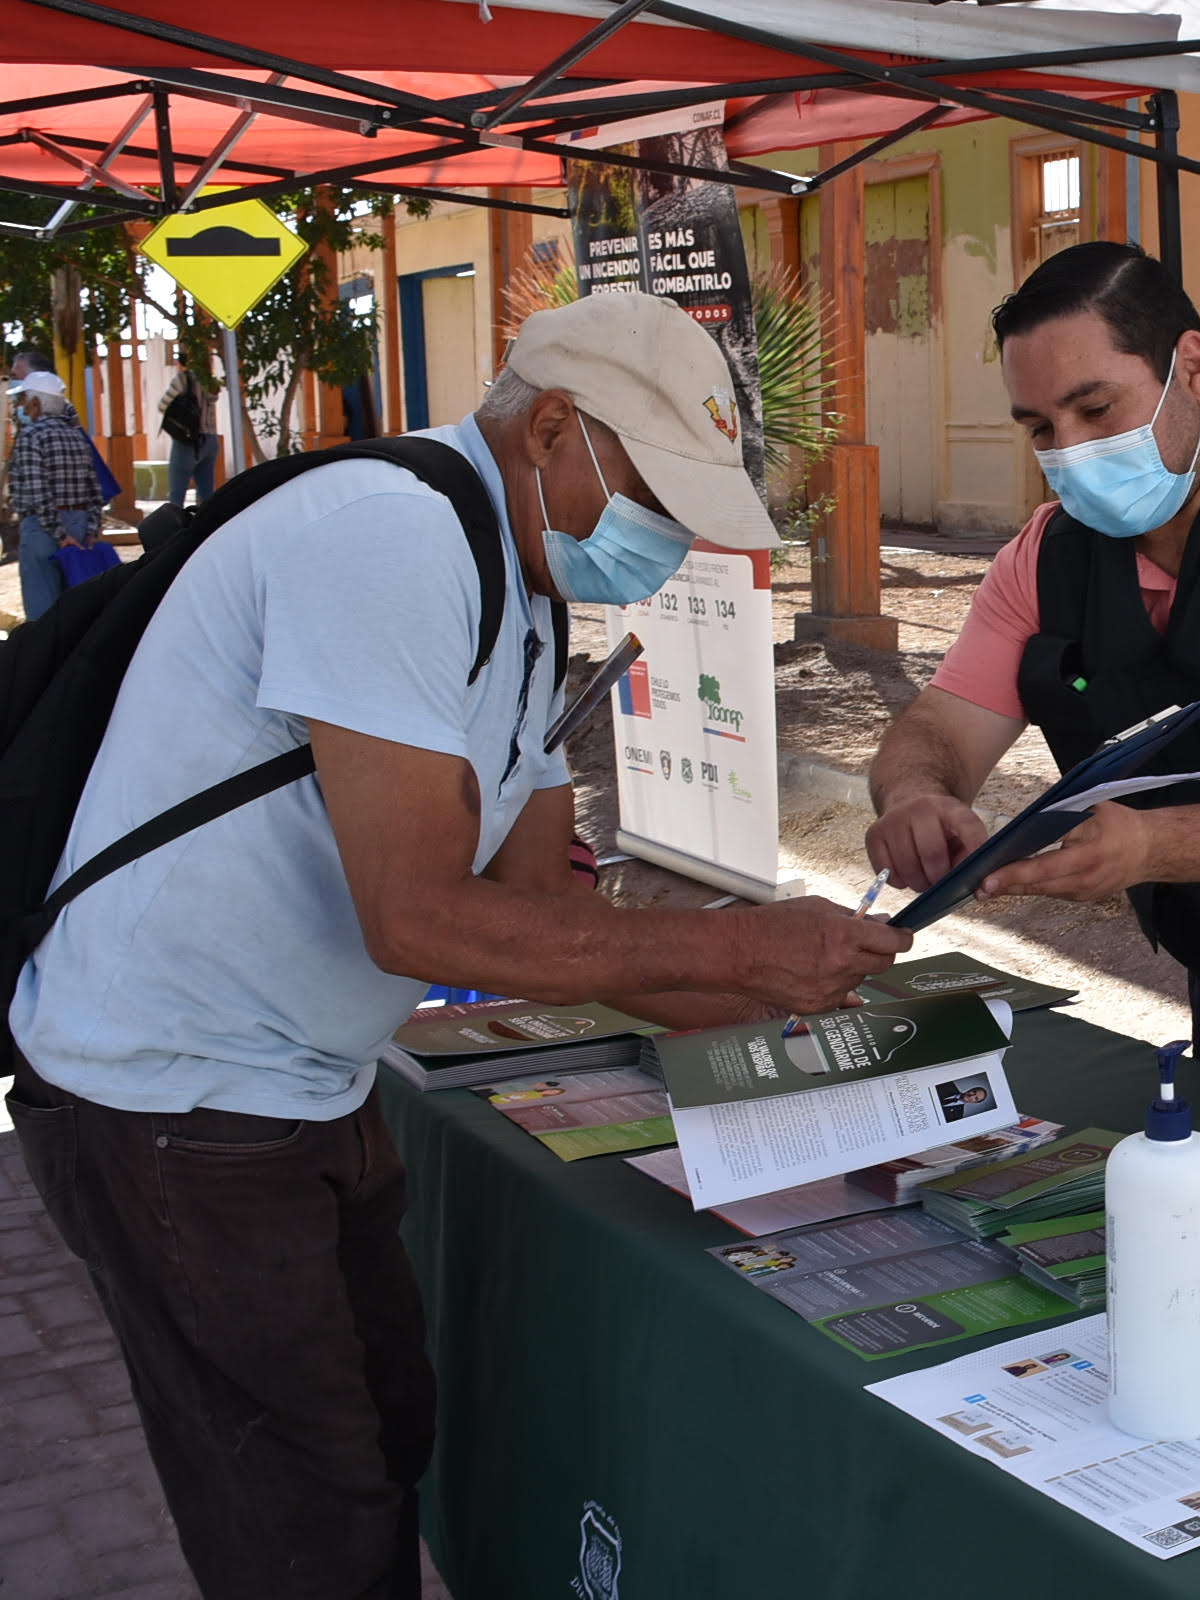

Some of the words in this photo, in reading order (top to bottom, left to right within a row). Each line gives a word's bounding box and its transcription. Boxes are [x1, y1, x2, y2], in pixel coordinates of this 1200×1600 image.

[693, 108, 722, 124] CONAF.CL
[589, 236, 638, 257] PREVENIR
[648, 232, 662, 250] ES
[579, 264, 592, 280] UN
[592, 258, 640, 278] INCENDIO
[688, 250, 716, 268] QUE
[652, 272, 732, 294] COMBATIRLO
[658, 592, 678, 611] 132
[688, 596, 706, 616] 133
[715, 600, 736, 620] 134
[625, 746, 653, 765] ONEMI
[701, 762, 719, 783] PDI
[819, 1017, 837, 1030] SER
[835, 1014, 849, 1023] EL
[839, 1022, 866, 1056] ORGULLO
[825, 1028, 854, 1071] GENDARME
[854, 1055, 871, 1068] DE
